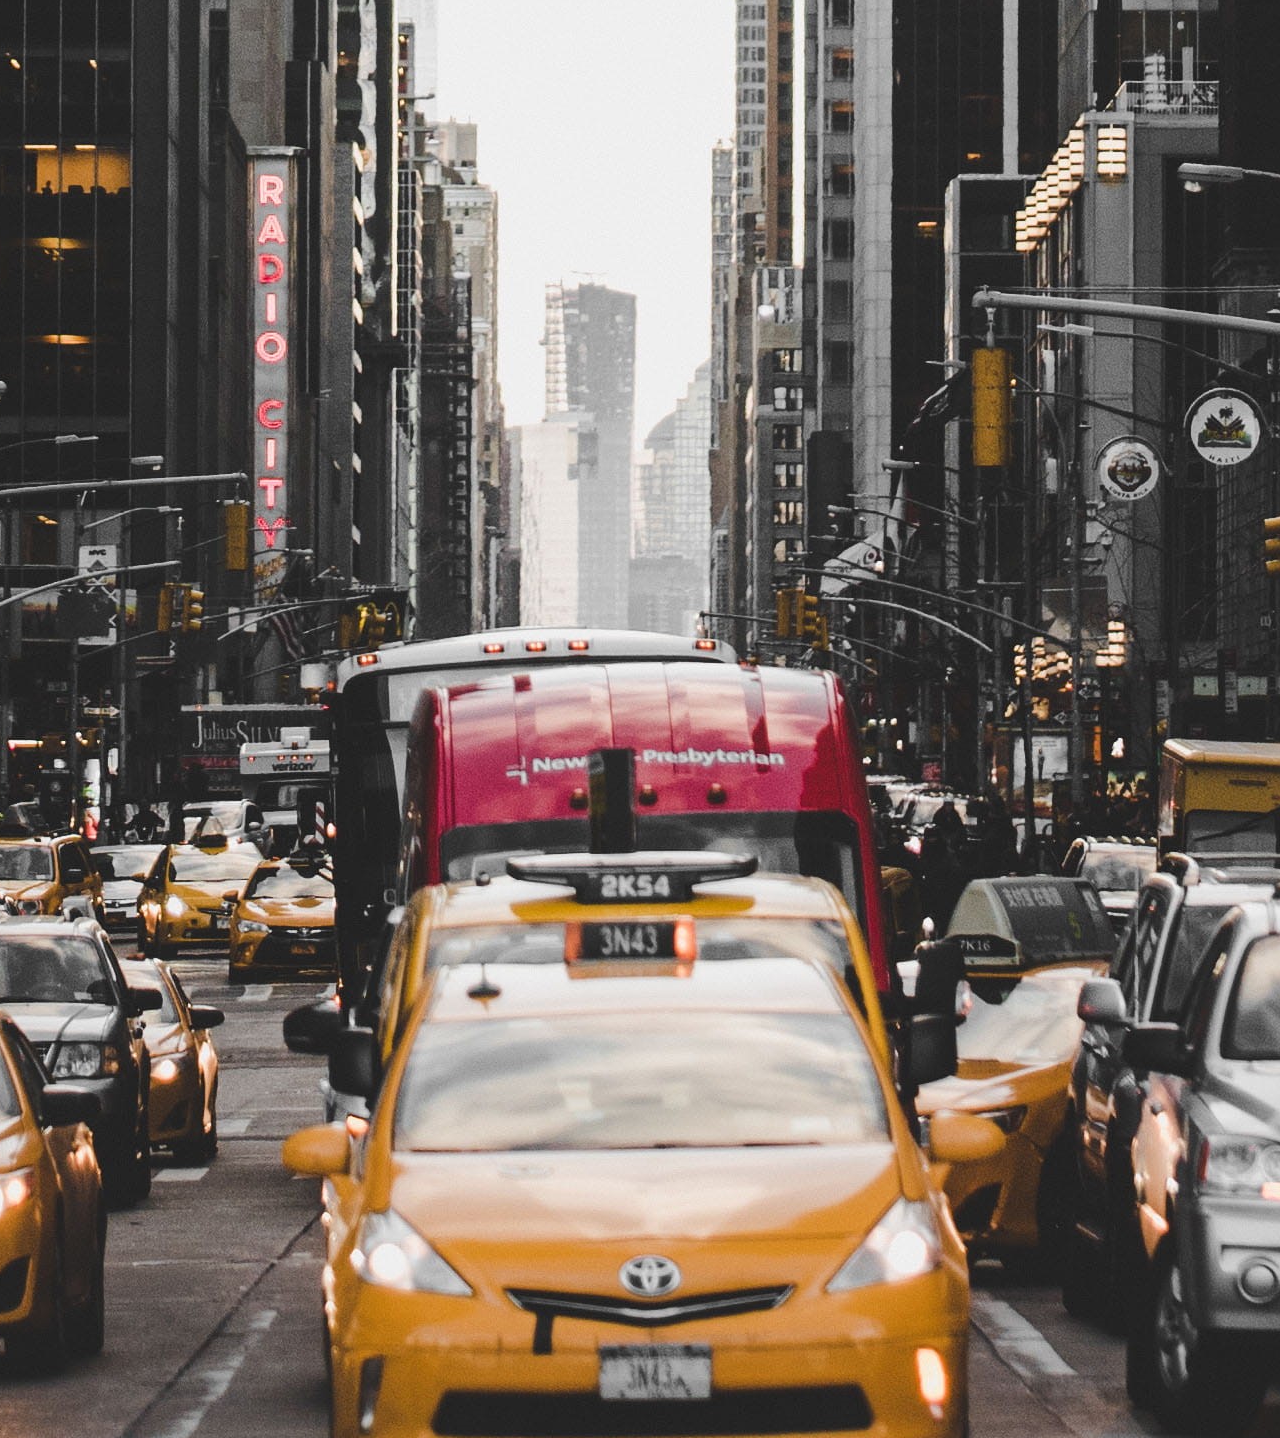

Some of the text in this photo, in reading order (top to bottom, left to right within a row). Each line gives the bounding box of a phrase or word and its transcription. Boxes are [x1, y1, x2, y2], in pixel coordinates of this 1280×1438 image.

[255, 174, 287, 362] RADIO
[254, 399, 291, 549] CITY
[192, 716, 237, 748] Julius
[272, 762, 317, 772] verizon
[600, 874, 671, 898] 2K54
[600, 925, 659, 956] 3N43
